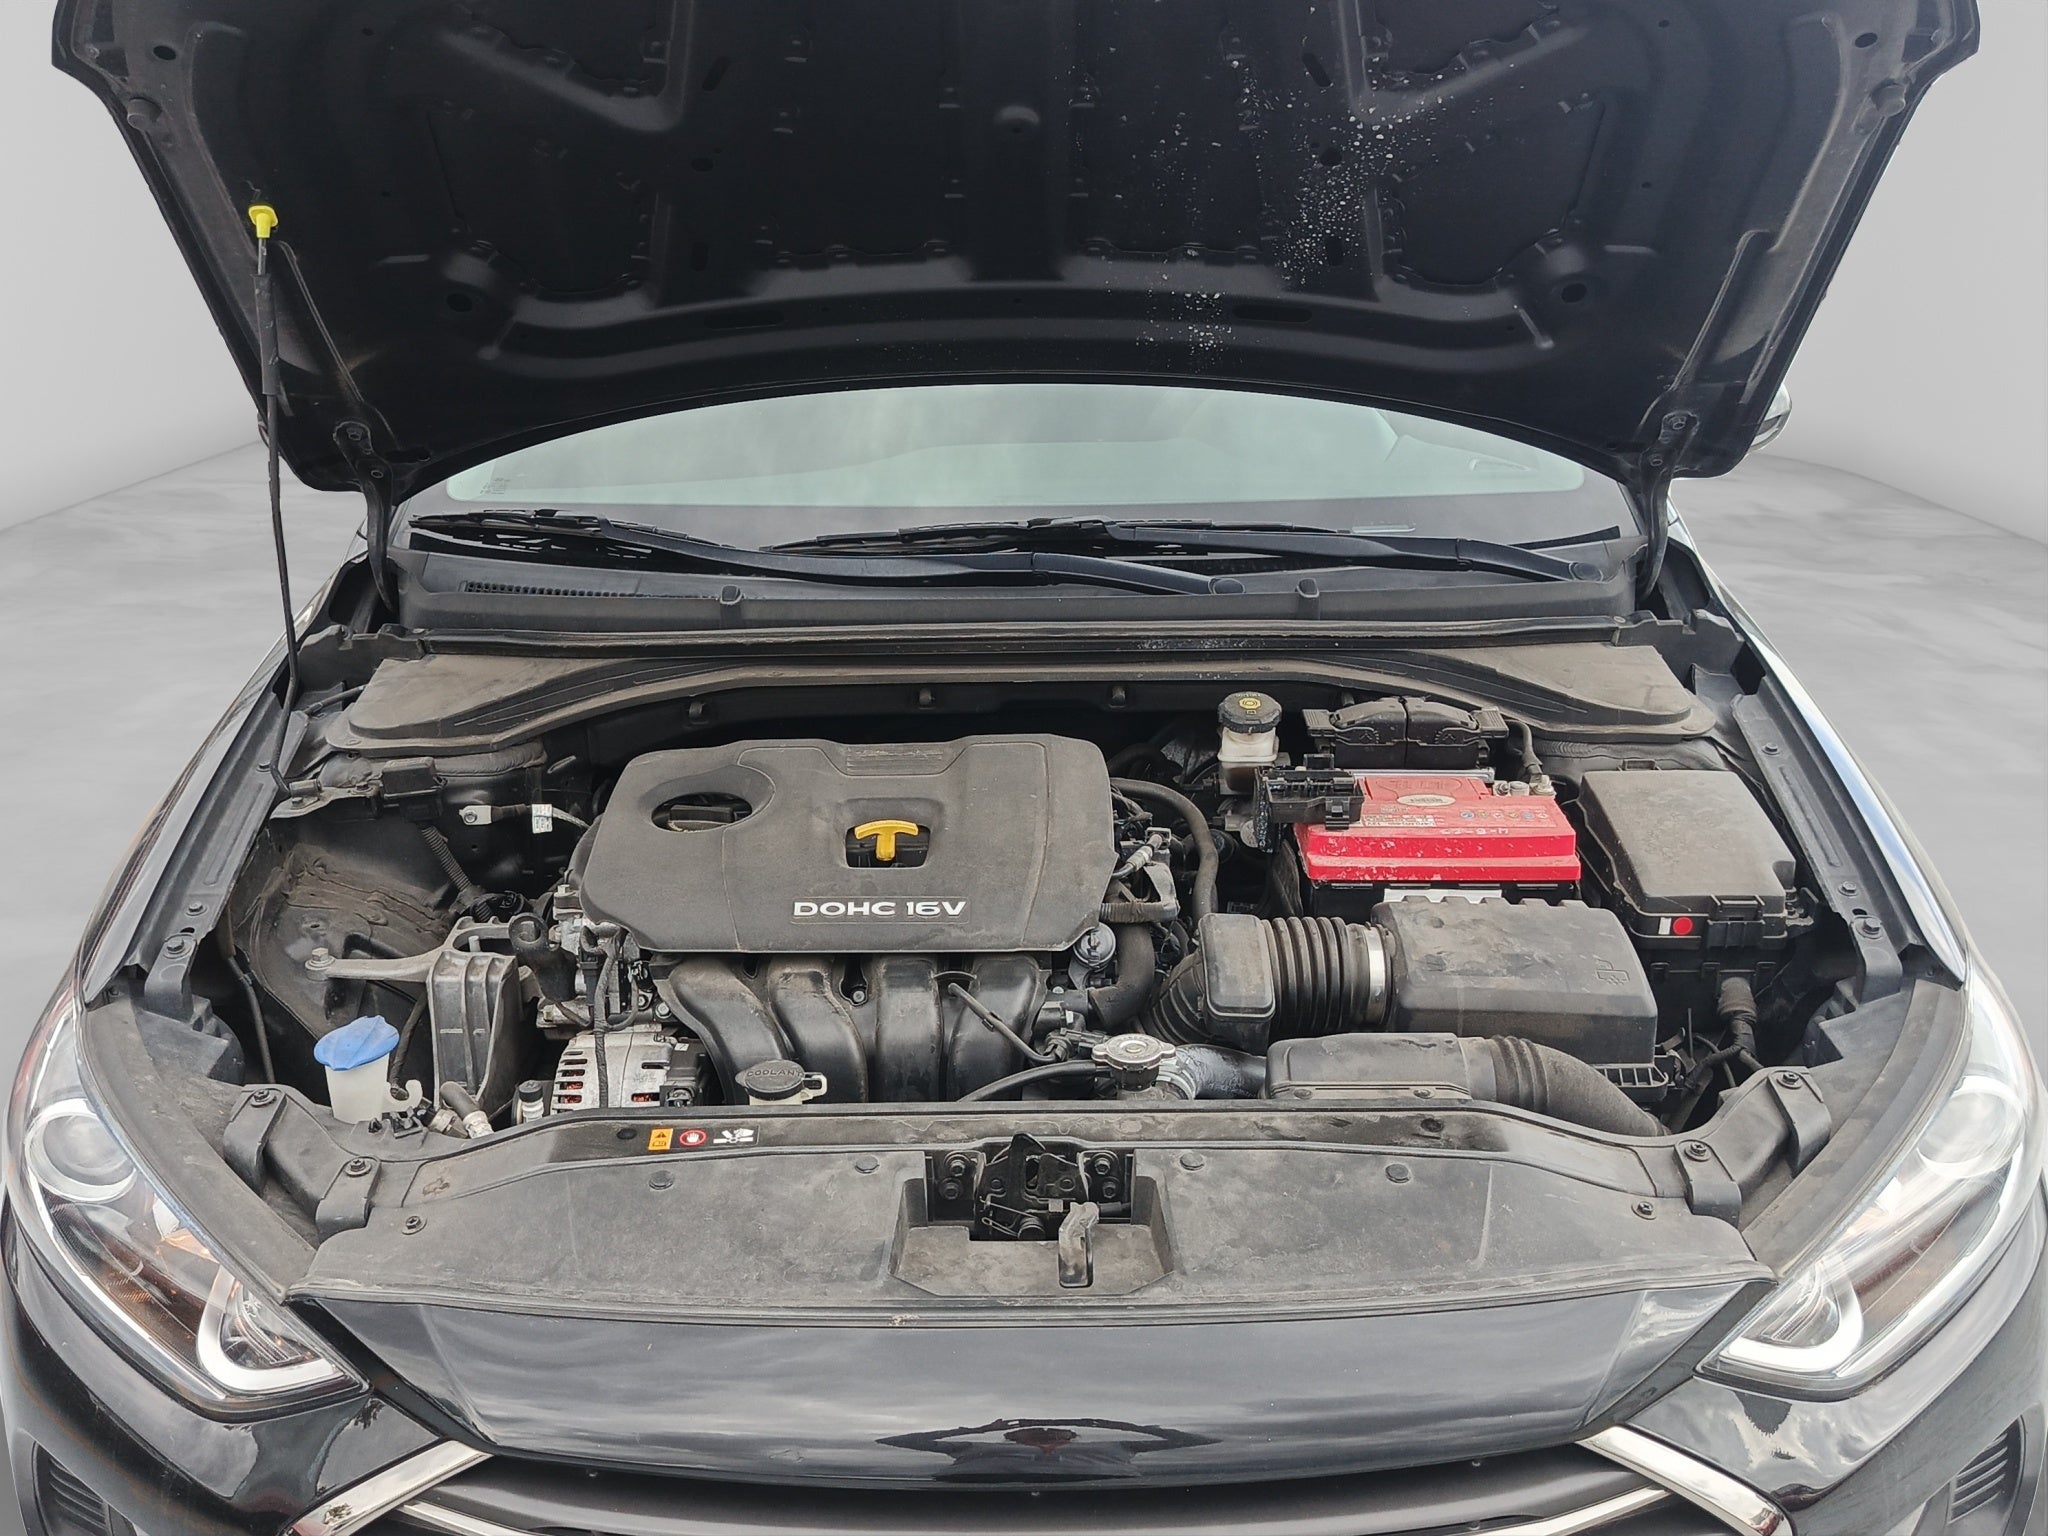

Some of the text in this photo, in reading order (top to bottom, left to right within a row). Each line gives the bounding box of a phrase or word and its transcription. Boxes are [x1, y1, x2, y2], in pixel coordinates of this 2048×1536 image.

[793, 901, 967, 916] DOHC 16V
[745, 1069, 804, 1077] COOLANT
